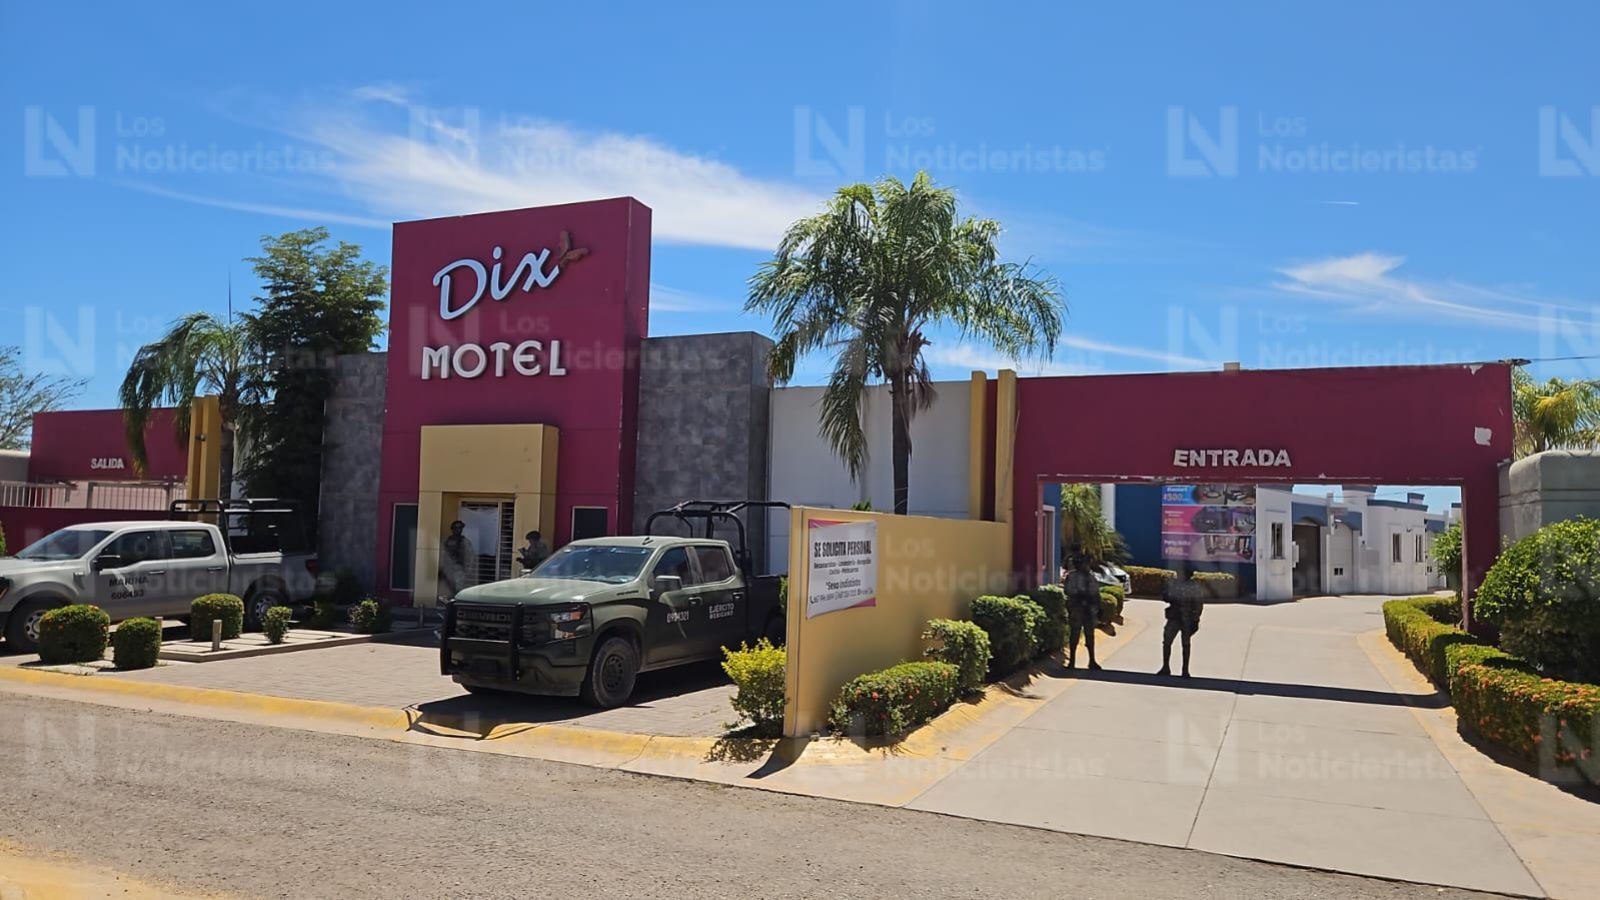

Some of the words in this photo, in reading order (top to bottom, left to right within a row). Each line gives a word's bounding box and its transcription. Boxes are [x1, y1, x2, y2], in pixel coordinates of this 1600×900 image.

[432, 246, 560, 321] Dix
[421, 339, 567, 380] MOTEL
[90, 457, 125, 470] SALIDA
[1173, 448, 1292, 467] ENTRADA
[814, 541, 821, 558] SE
[822, 541, 846, 557] SOLICITA
[847, 541, 872, 555] PERSONAL
